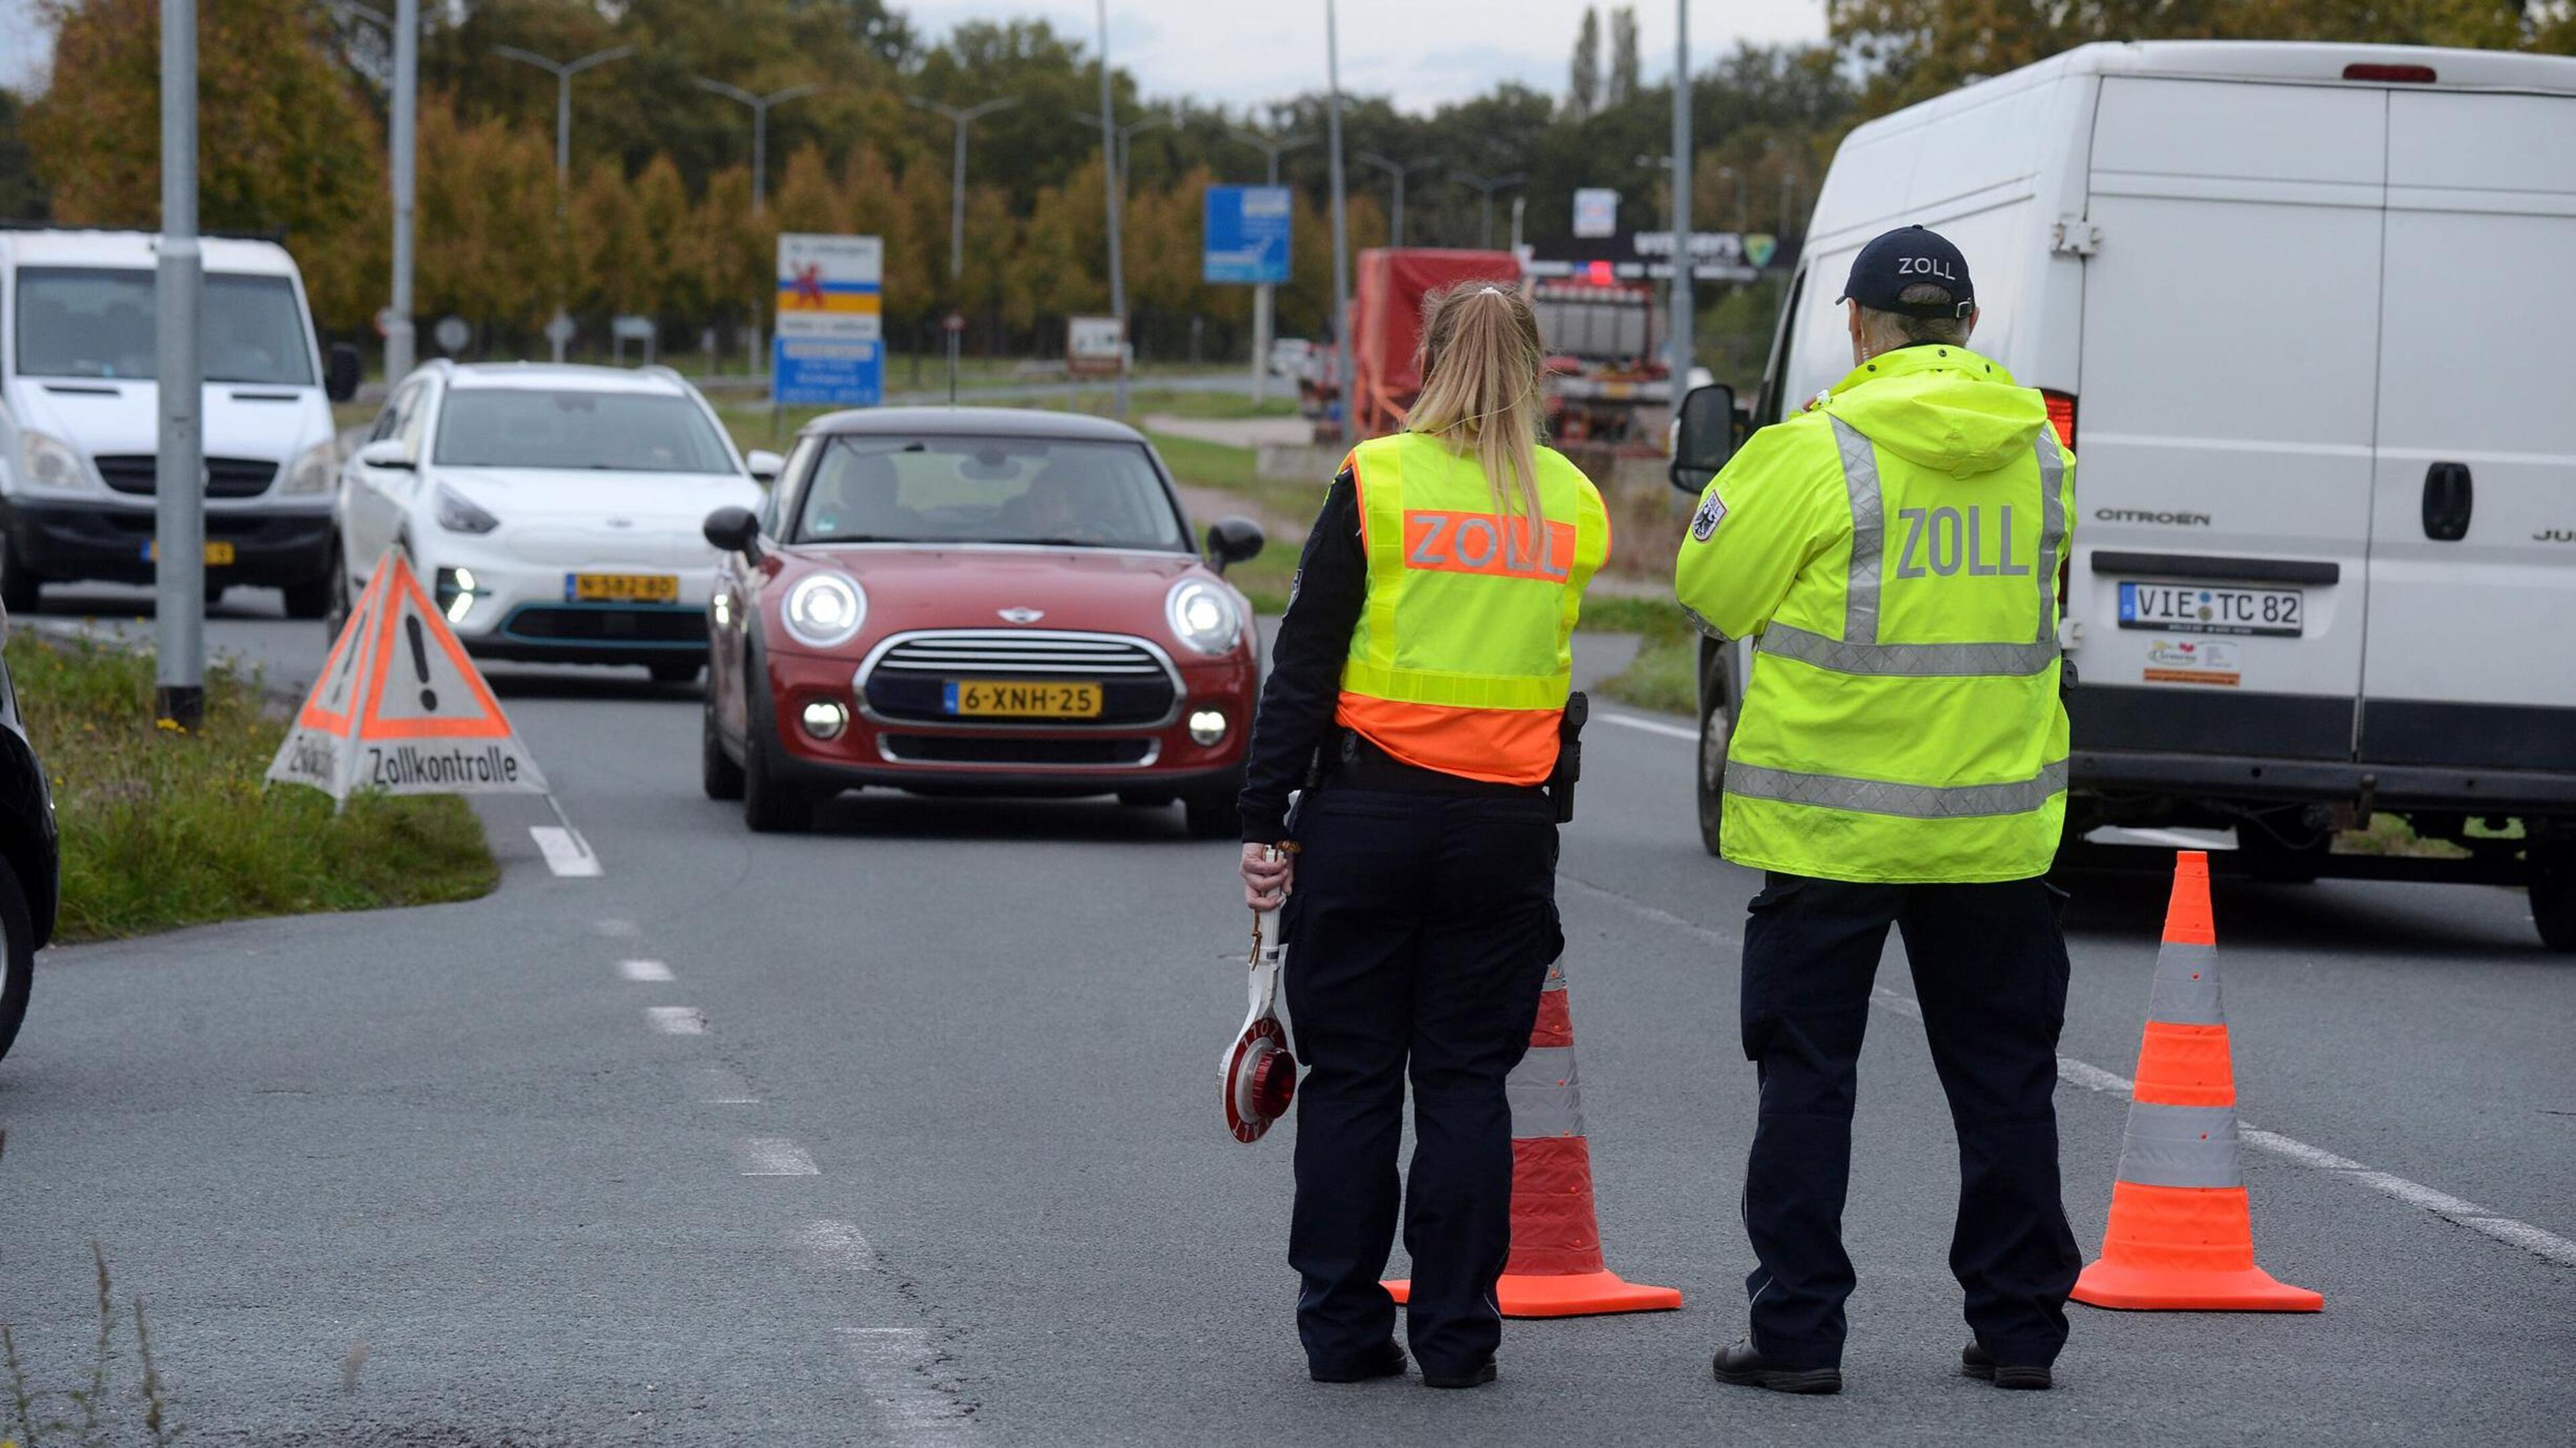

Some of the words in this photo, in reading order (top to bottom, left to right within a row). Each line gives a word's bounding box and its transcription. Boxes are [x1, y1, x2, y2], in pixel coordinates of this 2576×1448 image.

[1898, 258, 1956, 280] ZOLL
[1411, 515, 1568, 576] ZOLL
[1896, 505, 2029, 579] ZOLL
[2532, 530, 2576, 543] JU
[2139, 590, 2194, 618] VIE
[2217, 594, 2253, 621] TC
[2263, 596, 2298, 623] 82
[965, 687, 1091, 712] 6-XNH-25
[369, 746, 518, 785] Zollkontrolle
